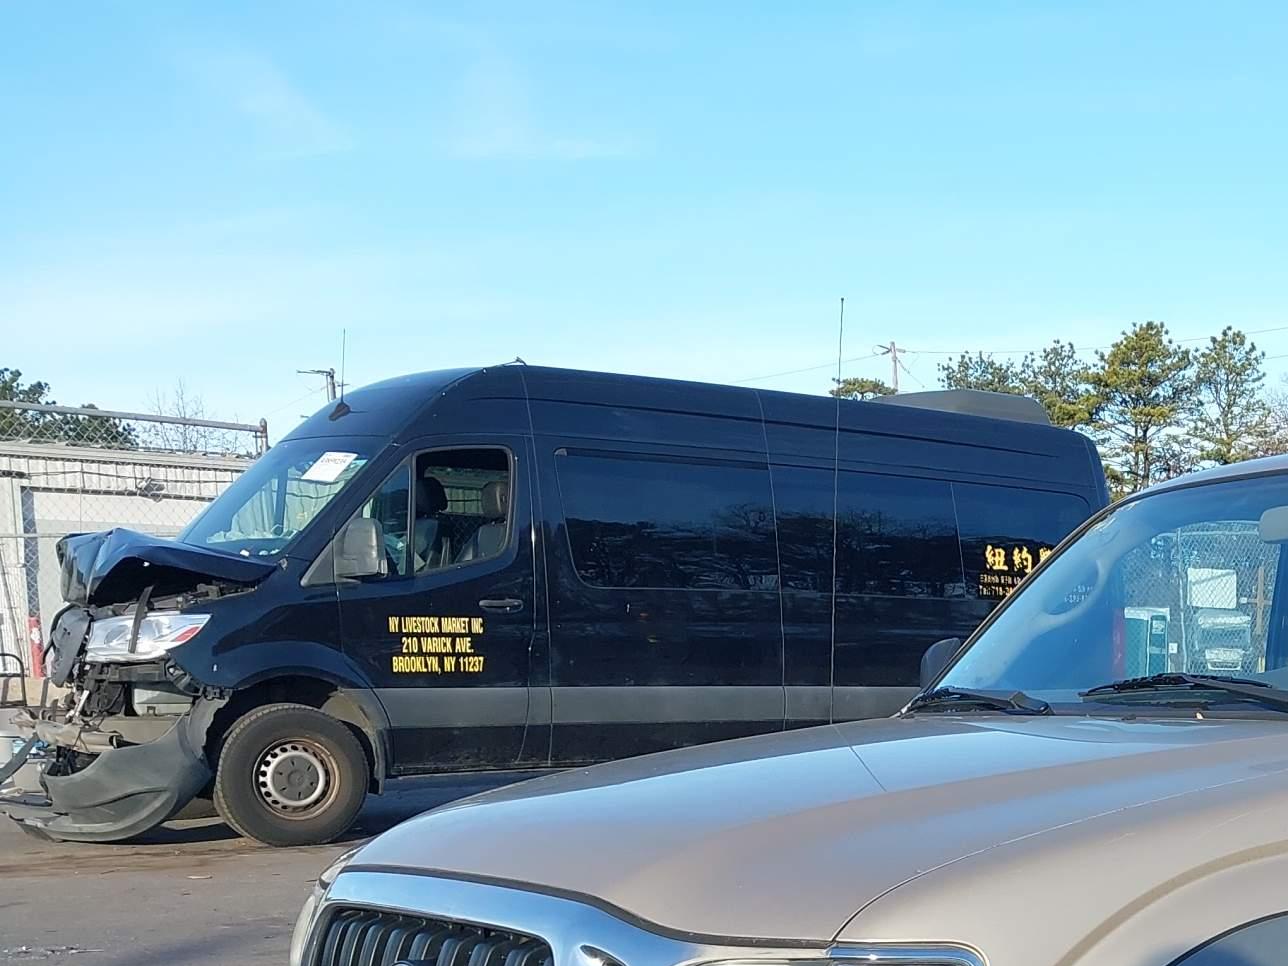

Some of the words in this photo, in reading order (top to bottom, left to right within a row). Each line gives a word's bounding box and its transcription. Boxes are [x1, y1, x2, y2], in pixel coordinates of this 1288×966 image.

[388, 616, 399, 633] NY
[401, 616, 440, 633] LIVESTOCK
[441, 617, 469, 634] MARKET
[471, 617, 484, 634] INC
[402, 636, 418, 653] 210
[421, 637, 453, 653] VARICK
[455, 637, 475, 653] AVE.
[392, 656, 442, 675] BROOKLYN,
[444, 656, 457, 673] NY
[458, 656, 484, 673] 11237
